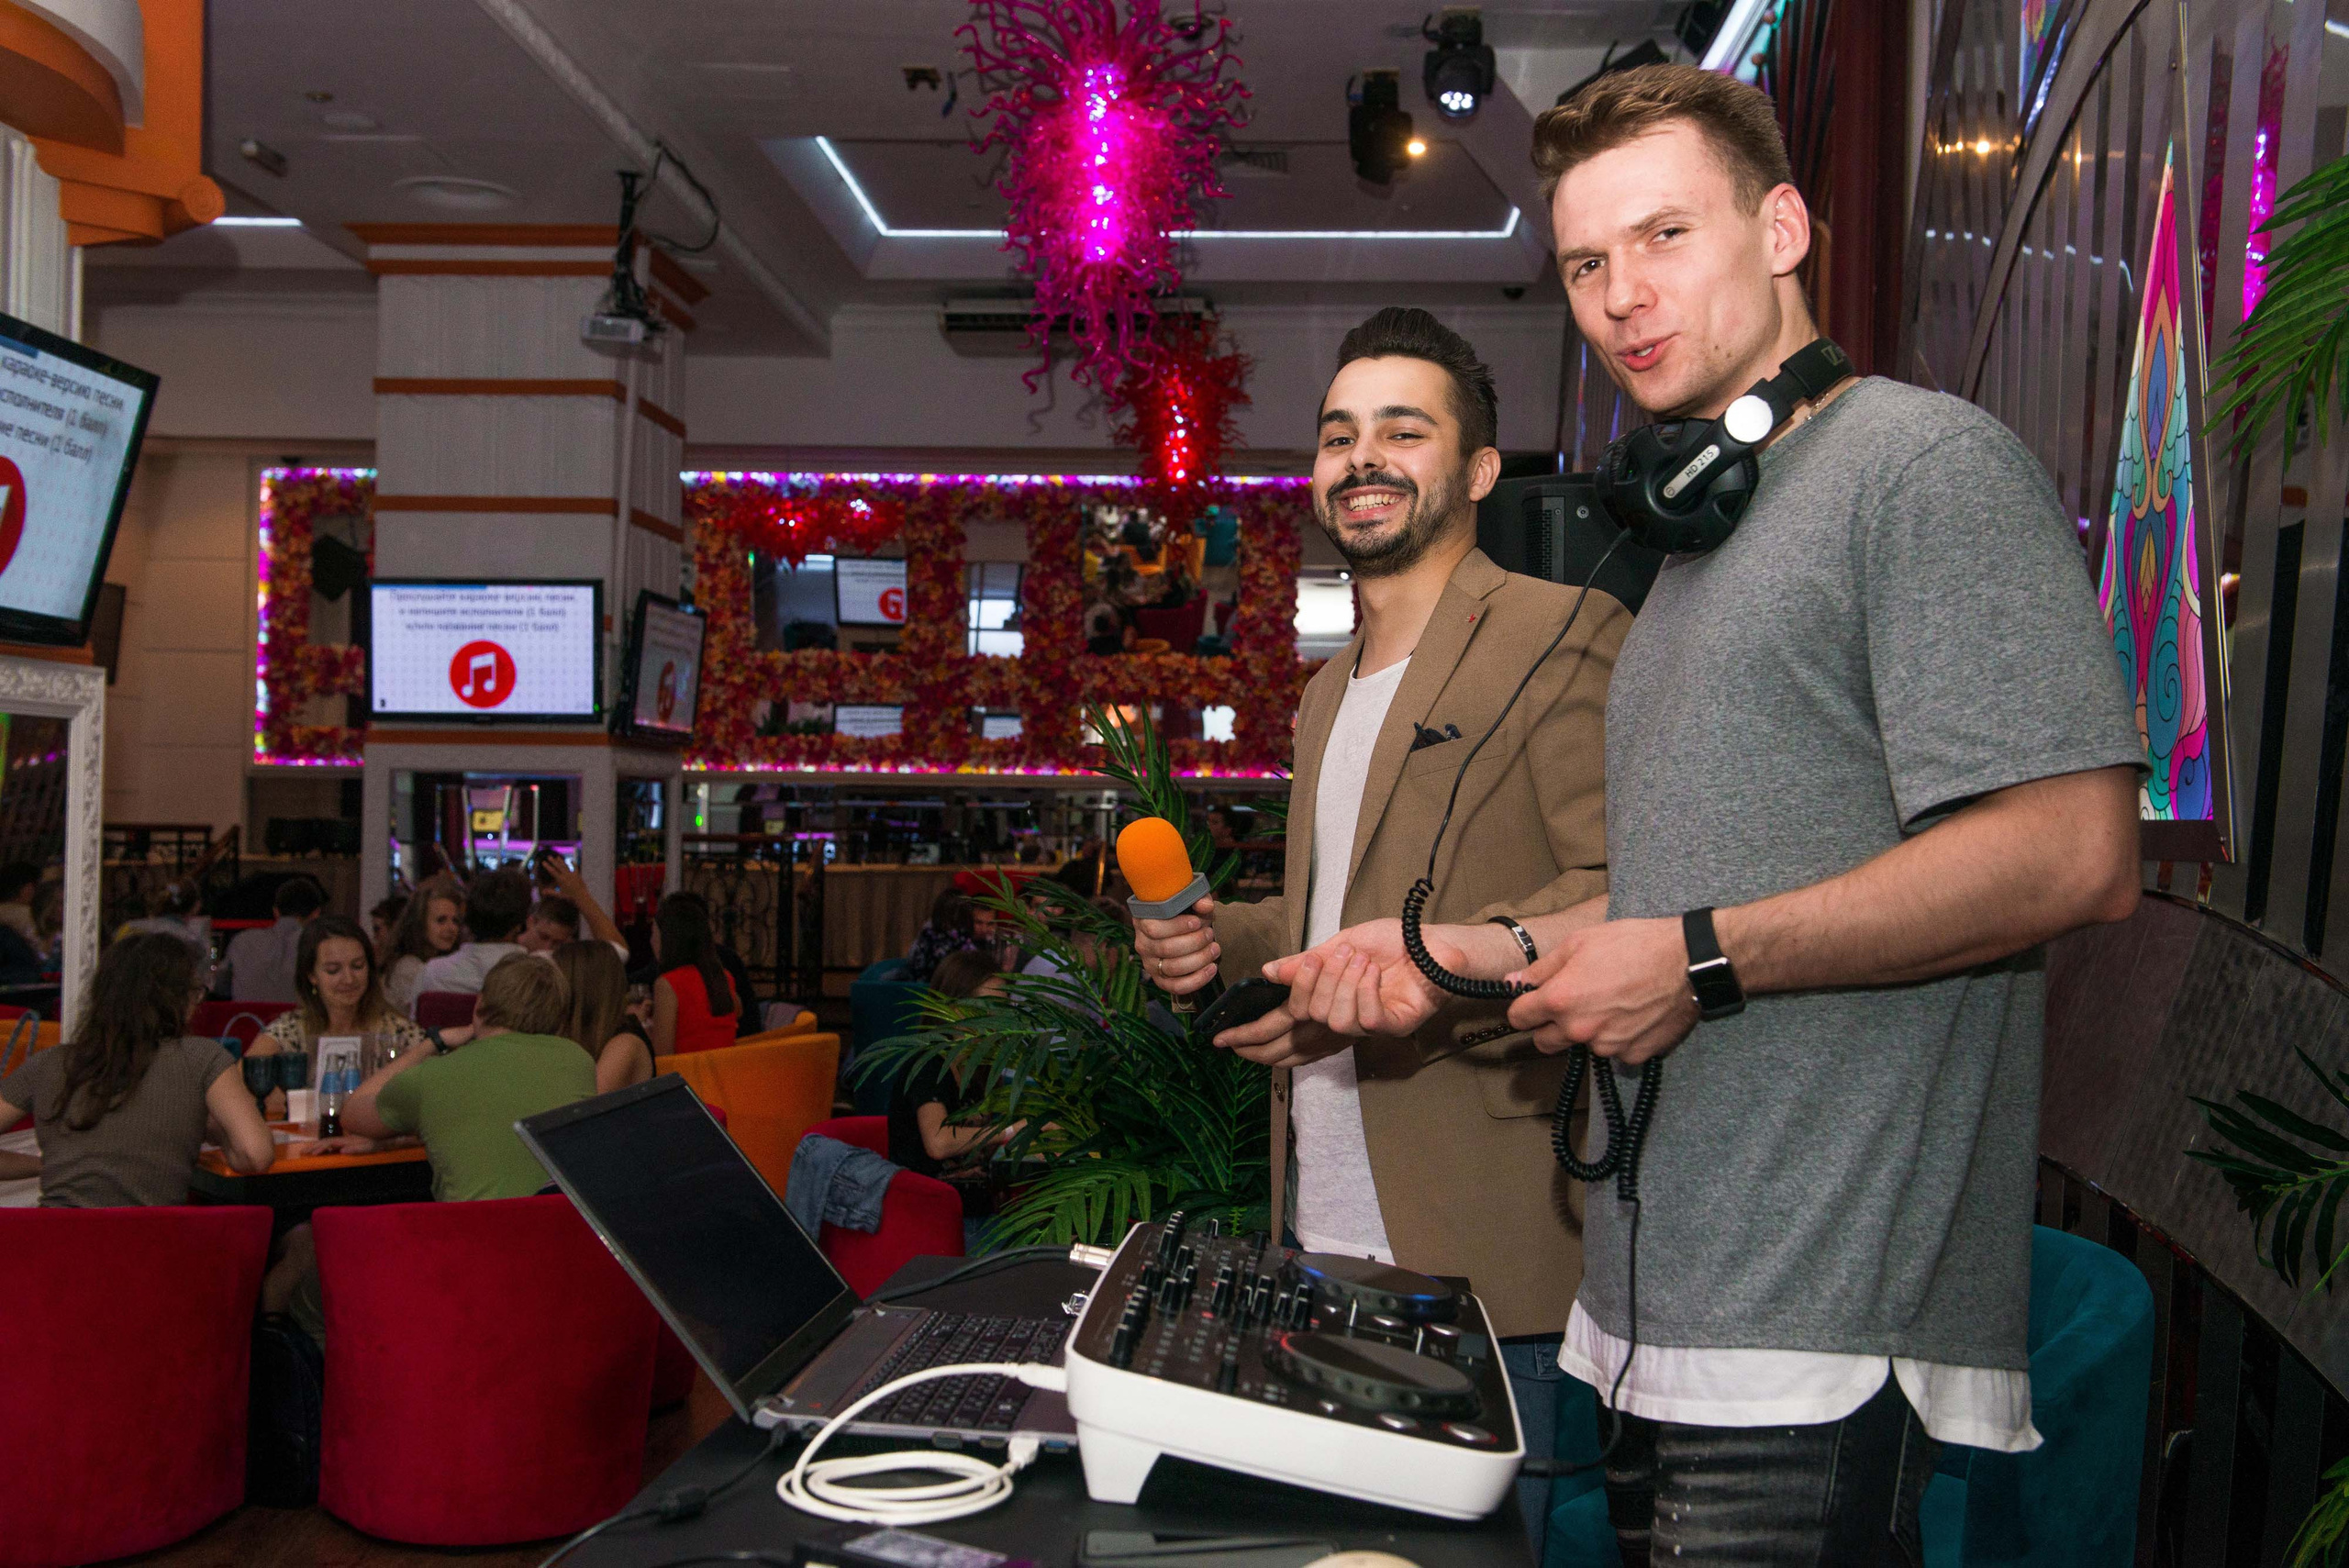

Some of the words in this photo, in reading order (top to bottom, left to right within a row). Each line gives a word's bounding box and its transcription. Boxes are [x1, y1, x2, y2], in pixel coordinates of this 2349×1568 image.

[0, 388, 65, 421] сполнителя
[1685, 464, 1698, 478] HD
[1697, 449, 1714, 466] 215
